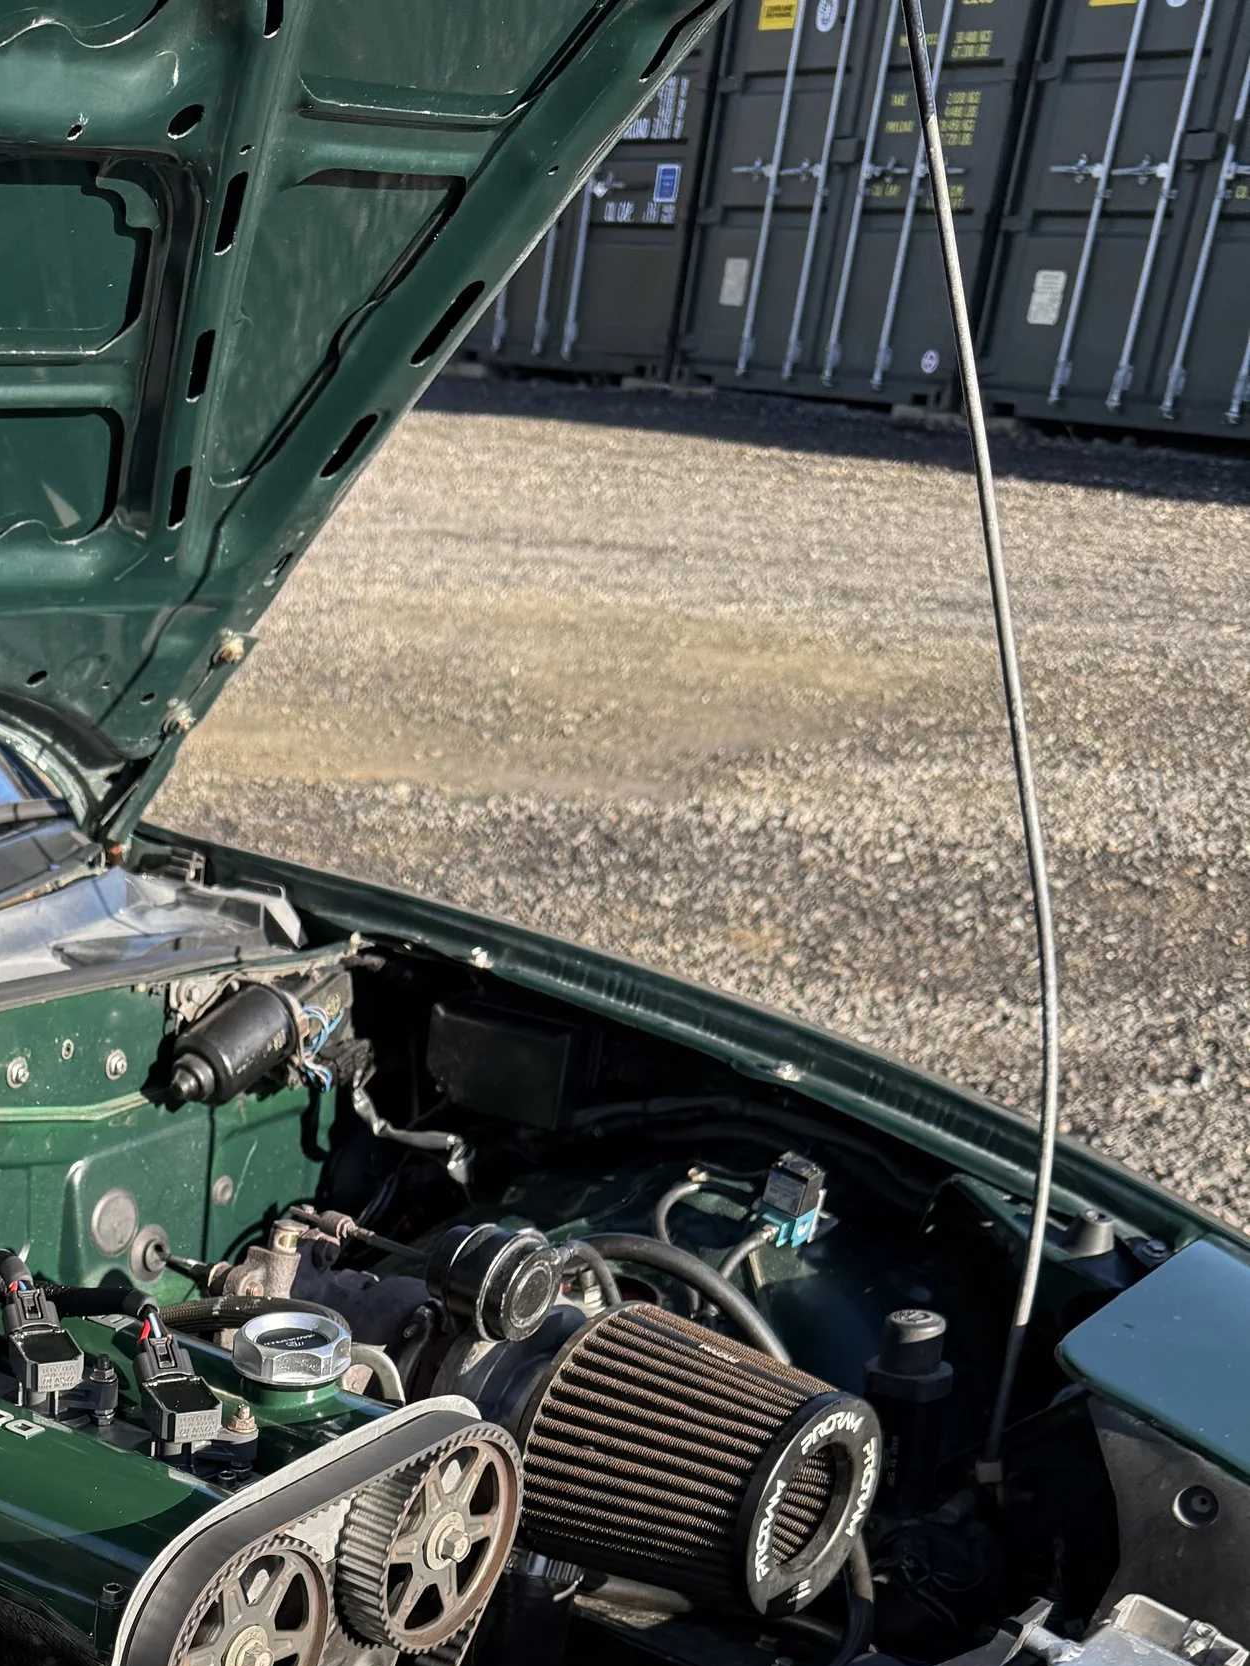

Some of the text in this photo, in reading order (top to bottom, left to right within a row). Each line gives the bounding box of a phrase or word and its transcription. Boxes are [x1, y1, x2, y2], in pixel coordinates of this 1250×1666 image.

[800, 1411, 866, 1456] PRORAM
[755, 1478, 788, 1584] PRORAM
[846, 1436, 878, 1538] PRORAM
